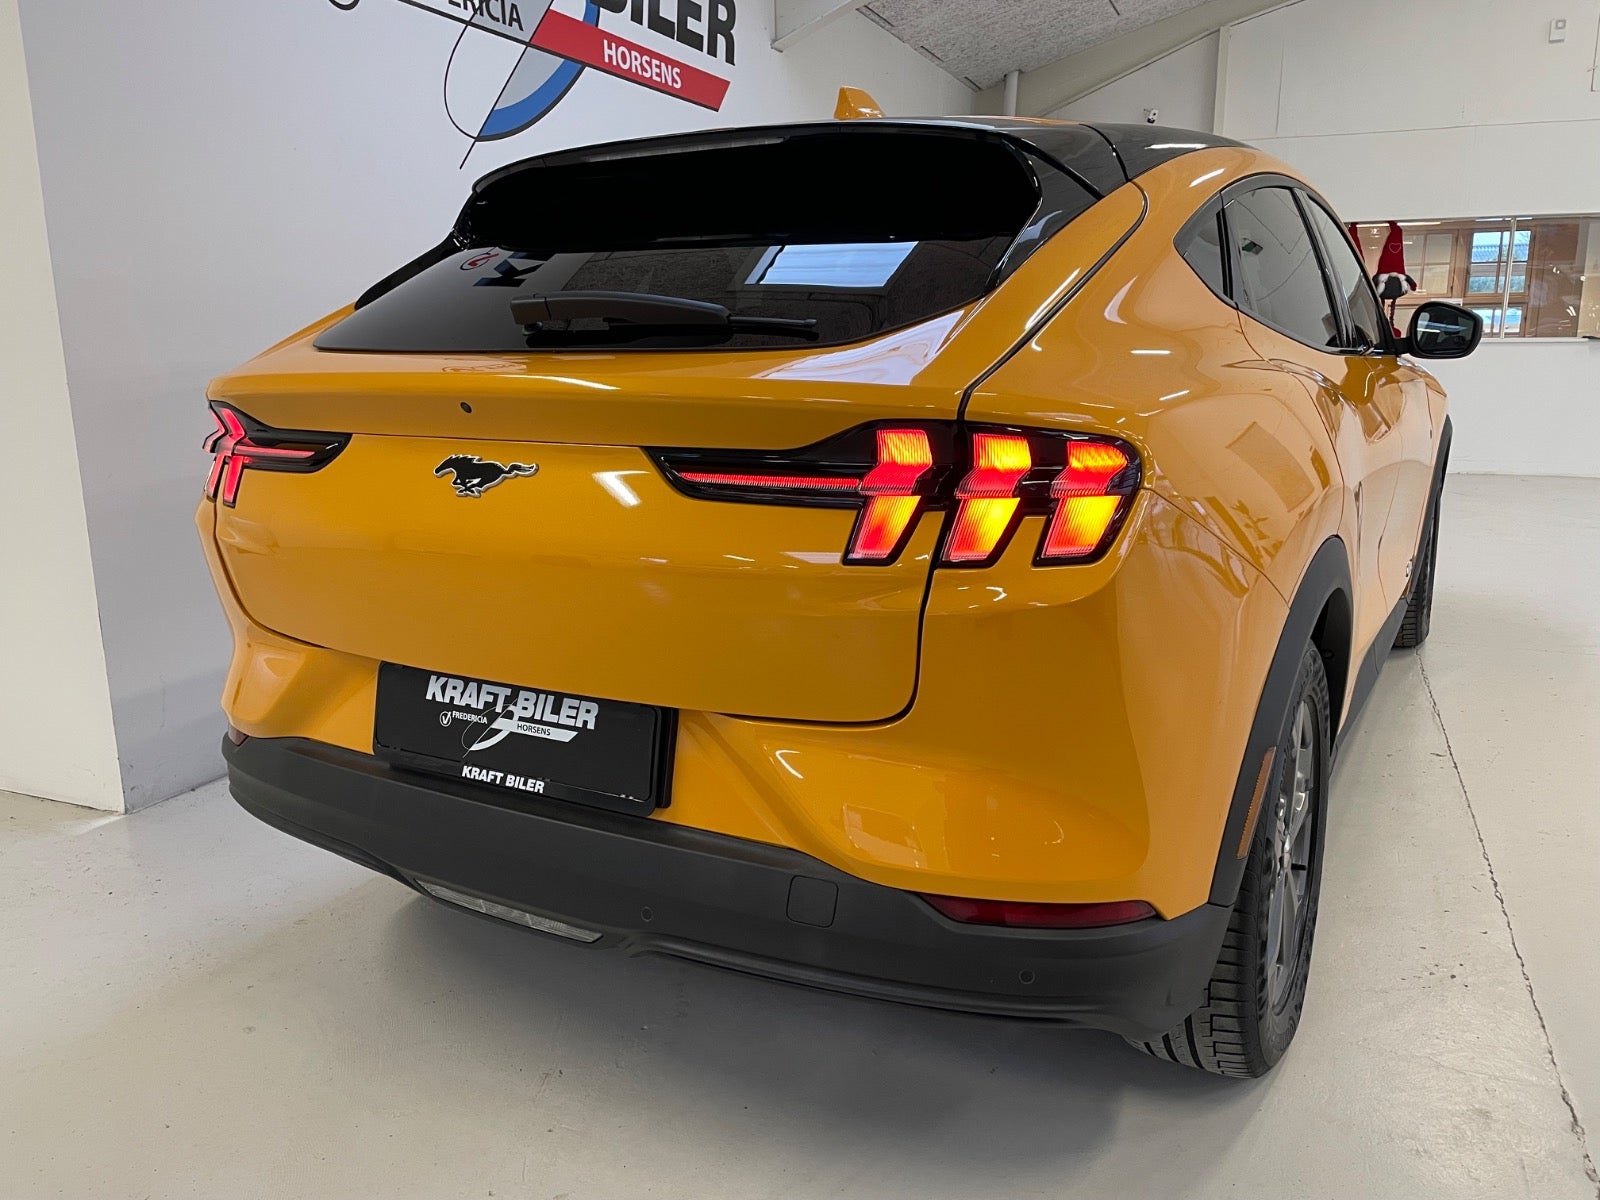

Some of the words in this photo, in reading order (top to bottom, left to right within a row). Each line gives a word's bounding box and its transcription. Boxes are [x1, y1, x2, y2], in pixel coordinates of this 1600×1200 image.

[603, 39, 682, 89] HORSENS
[425, 675, 511, 713] KRAFT
[516, 690, 599, 730] BILER
[452, 710, 488, 724] FREDERICIA
[516, 723, 551, 736] HORSENS
[461, 765, 504, 785] KRAFT
[505, 774, 545, 794] BILER
